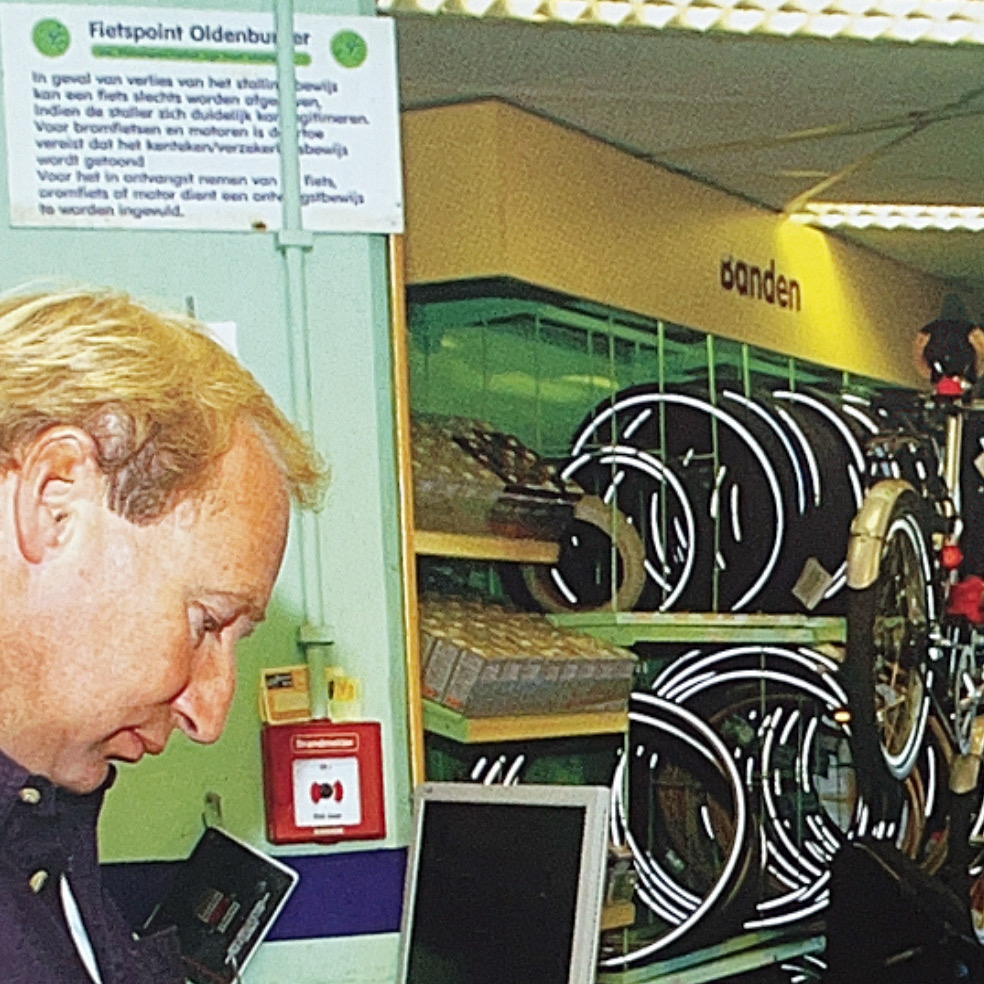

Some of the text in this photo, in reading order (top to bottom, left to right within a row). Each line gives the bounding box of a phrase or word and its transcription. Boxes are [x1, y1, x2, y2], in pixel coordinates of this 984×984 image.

[88, 20, 312, 46] Fietspoint Oldenburer
[32, 71, 47, 84] In
[51, 72, 92, 88] geval
[95, 74, 123, 86] van
[126, 74, 173, 87] verlies
[176, 76, 204, 88] van
[208, 75, 231, 89] het
[32, 87, 61, 101] kan
[65, 90, 93, 101] een
[97, 88, 129, 102] fiets
[133, 90, 182, 104] slechts
[185, 92, 240, 105] worden
[33, 104, 80, 117] Indien
[85, 105, 103, 117] de
[109, 106, 153, 118] staller
[158, 108, 186, 120] zich
[190, 109, 252, 124] duidelijk
[34, 120, 69, 134] Voor
[73, 121, 162, 135] bromfietsen
[166, 124, 184, 136] en
[188, 125, 248, 137] motoren
[252, 125, 264, 138] is
[35, 137, 84, 150] vereist
[88, 137, 113, 150] dat
[117, 138, 141, 151] het
[36, 154, 145, 170] wordt getoond
[36, 169, 72, 183] Voor
[76, 169, 101, 183] het
[104, 170, 119, 183] in
[123, 173, 194, 188] ontvangst
[198, 175, 248, 186] nemen
[252, 176, 278, 187] van
[113, 187, 129, 200] of
[133, 188, 176, 201] motor
[180, 188, 217, 201] dient
[221, 191, 248, 202] een
[38, 202, 55, 216] te
[58, 203, 115, 217] worden
